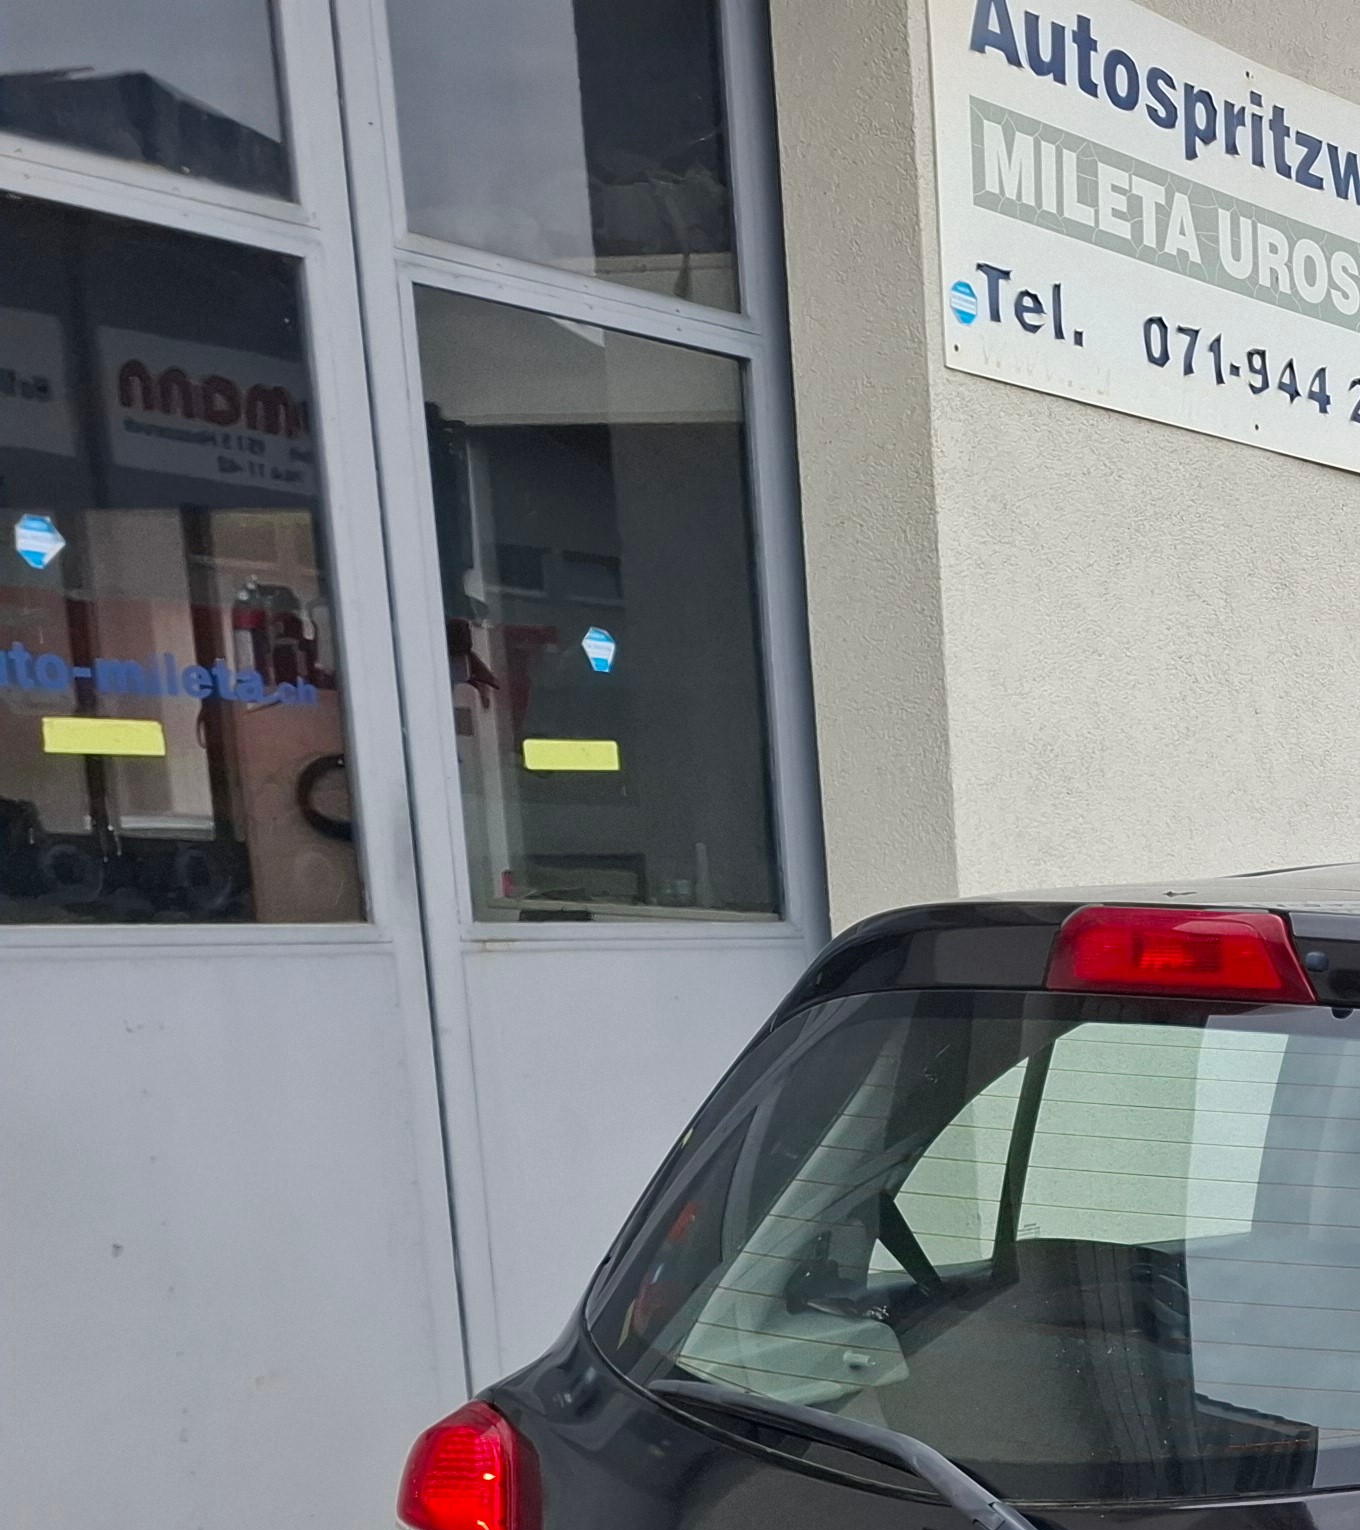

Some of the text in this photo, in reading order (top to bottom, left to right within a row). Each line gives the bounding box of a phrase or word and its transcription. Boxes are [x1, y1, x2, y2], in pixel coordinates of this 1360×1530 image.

[981, 118, 1203, 264] MILETA
[976, 262, 1084, 348] Tel.
[1143, 316, 1332, 415] 071-944
